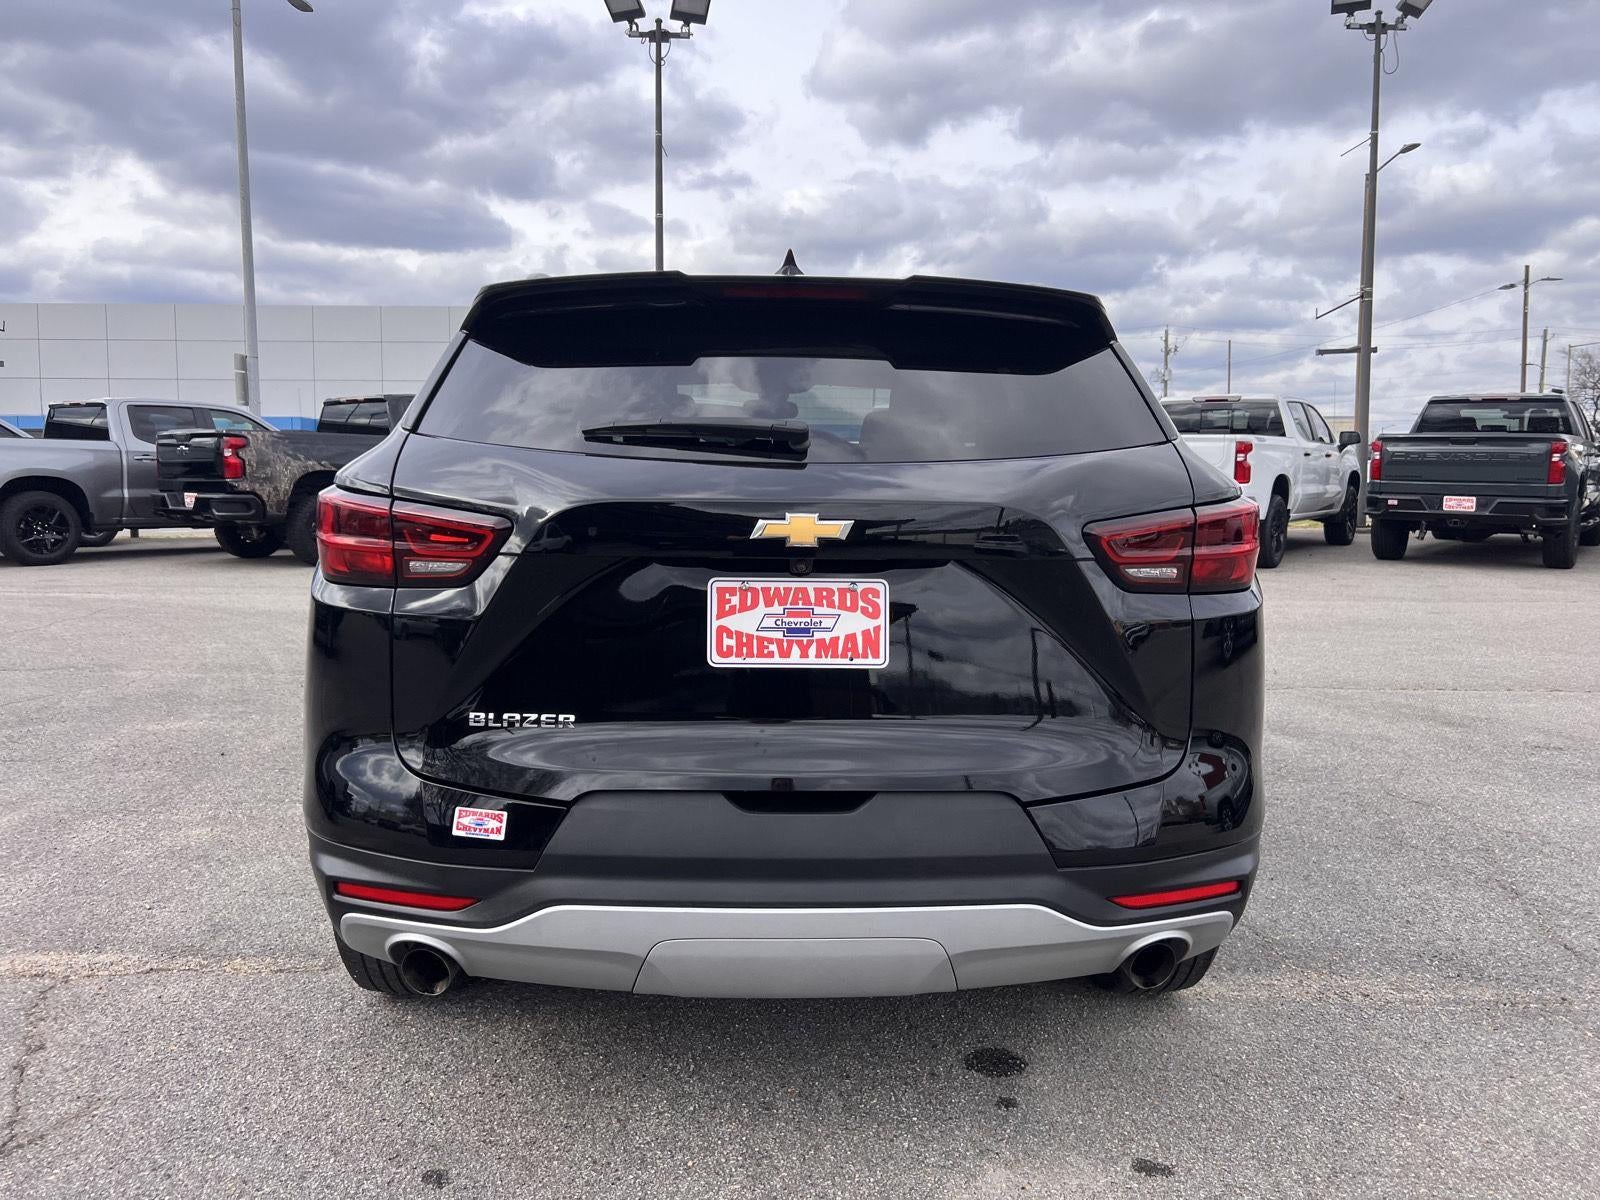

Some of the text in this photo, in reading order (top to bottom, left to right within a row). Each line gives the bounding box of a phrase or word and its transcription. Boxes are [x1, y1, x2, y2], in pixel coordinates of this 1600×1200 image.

[1391, 451, 1538, 462] CHEVROLET
[716, 586, 881, 621] EDWARDS
[774, 618, 823, 628] Chevrolet
[716, 624, 881, 660] CHEVYMAN
[468, 712, 576, 729] BLAZER
[457, 809, 504, 824] EDWARDS
[456, 820, 503, 835] CHEVYMAN
